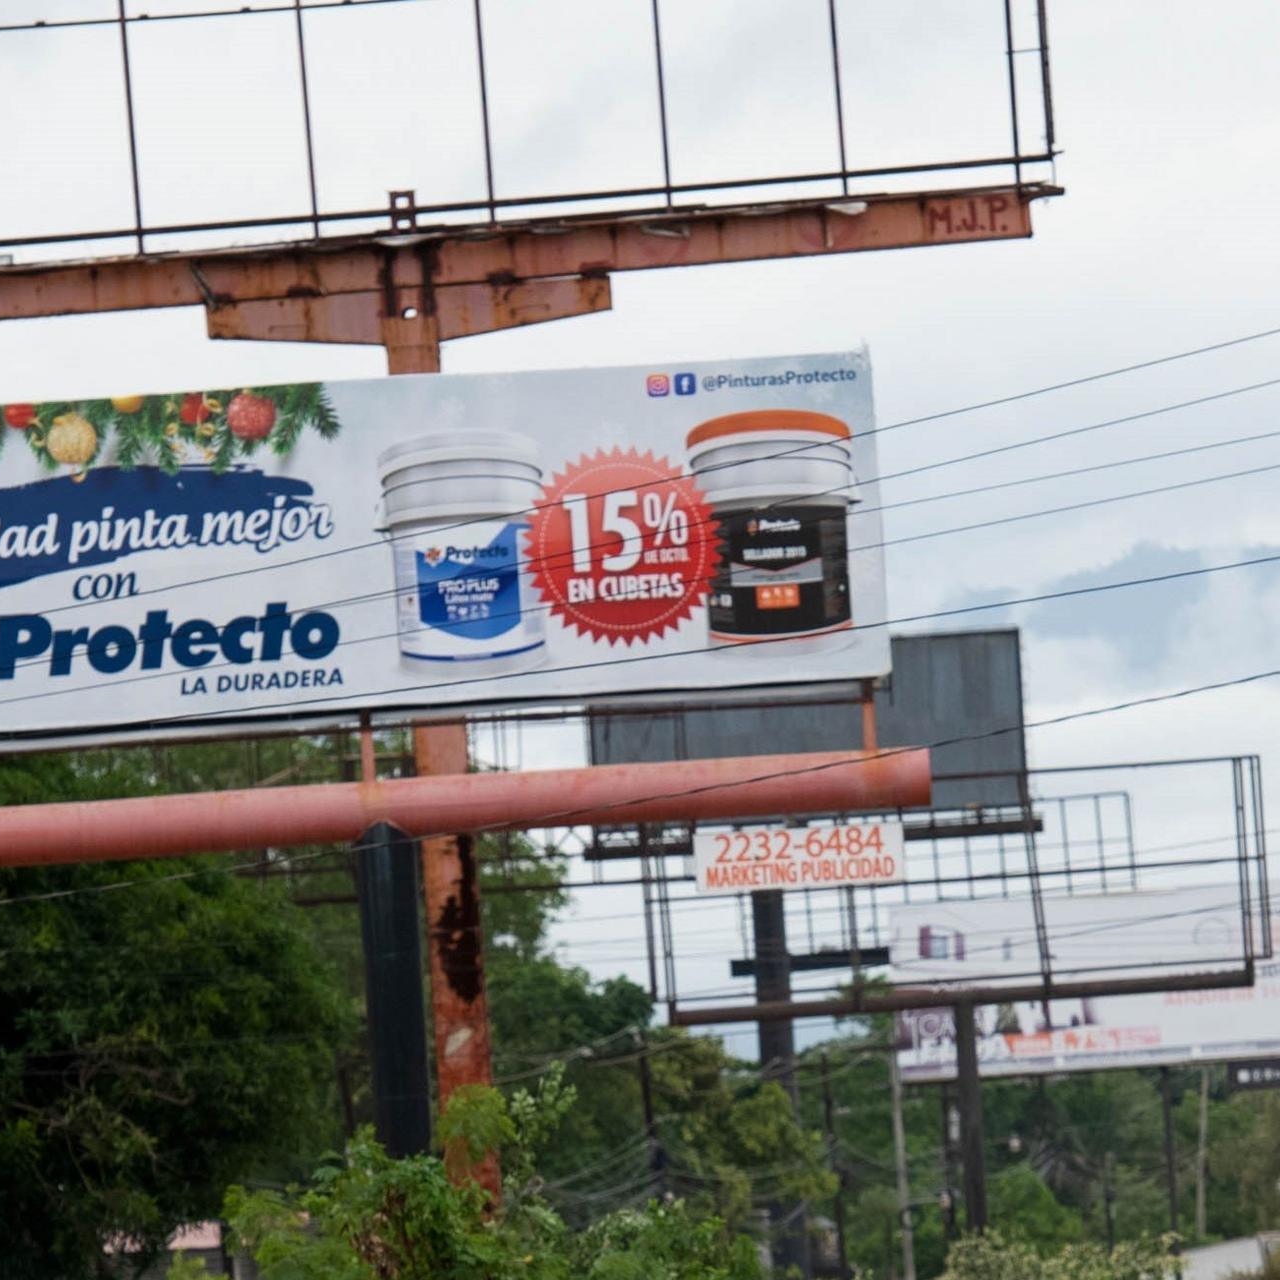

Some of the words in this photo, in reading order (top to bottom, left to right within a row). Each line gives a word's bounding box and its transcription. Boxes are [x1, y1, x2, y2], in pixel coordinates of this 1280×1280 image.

[928, 195, 1008, 235] M.J.P.
[702, 367, 857, 391] @PinturasProtecto
[69, 506, 191, 562] pinta
[201, 496, 334, 552] mejor
[562, 490, 689, 573] 15%
[73, 572, 139, 600] con
[567, 577, 595, 603] EN
[598, 571, 686, 603] CUBETAS
[180, 677, 208, 696] LA
[216, 667, 344, 694] DURADERA
[714, 824, 883, 864] 2232-6484
[705, 862, 798, 888] MARKETING
[801, 855, 895, 882] PUBLICIDAD
